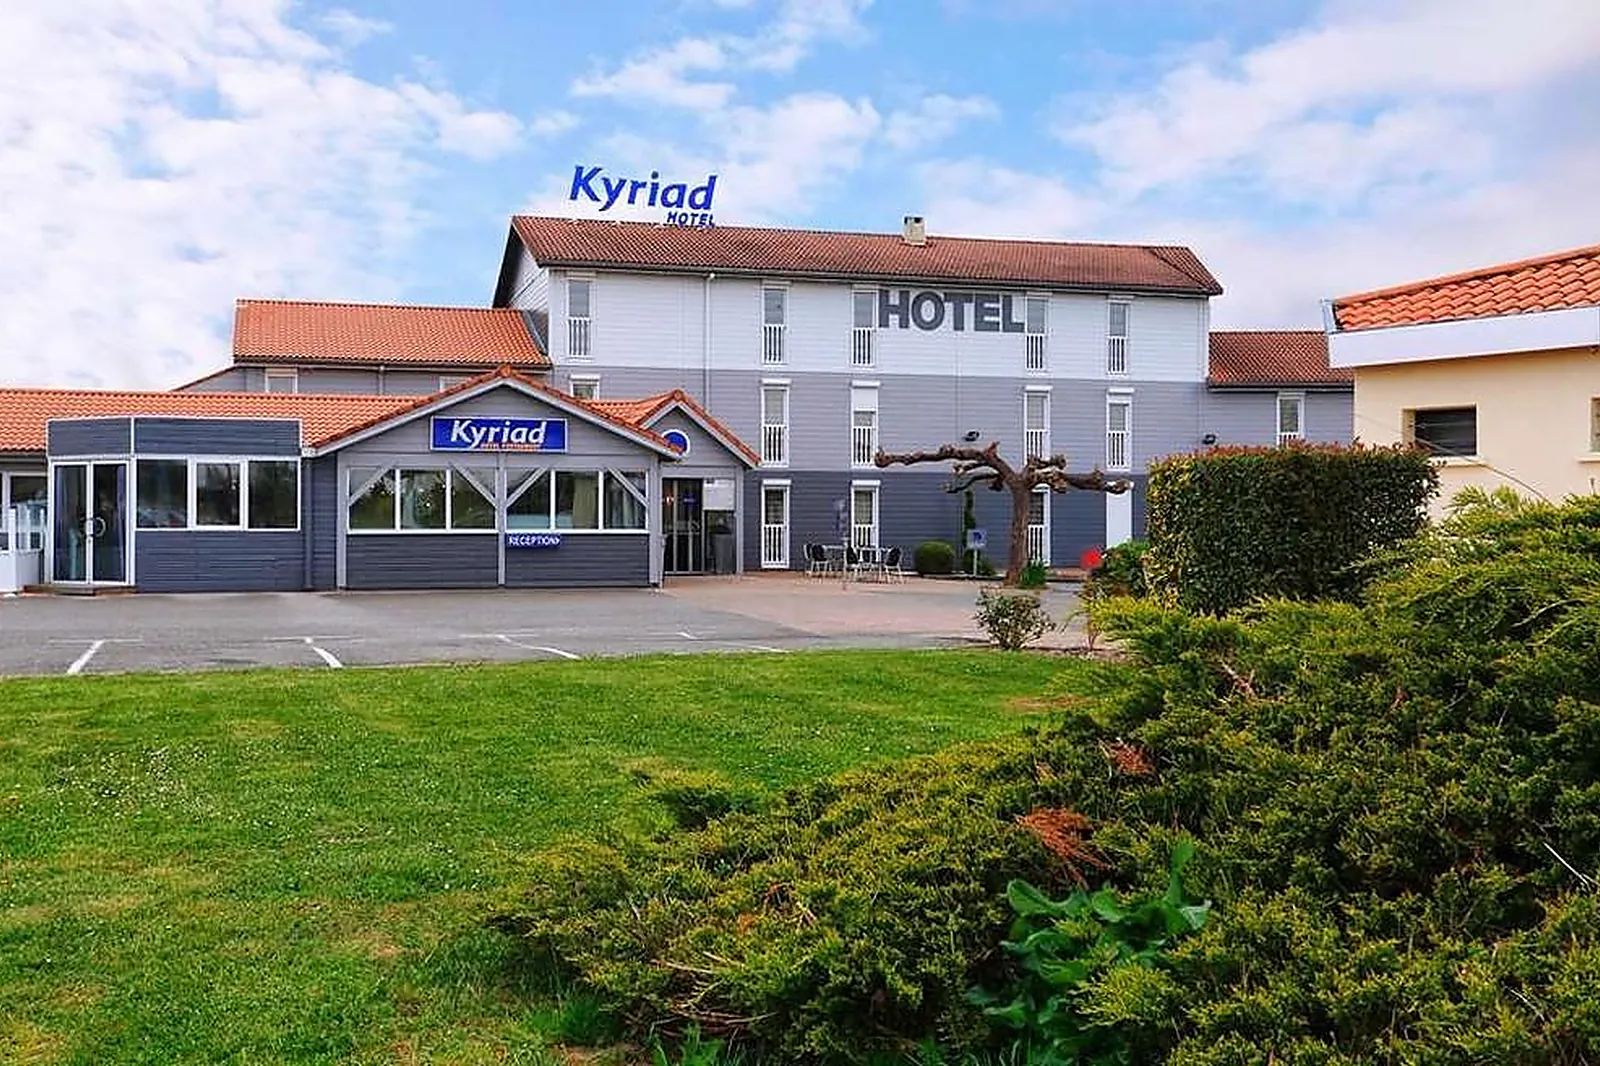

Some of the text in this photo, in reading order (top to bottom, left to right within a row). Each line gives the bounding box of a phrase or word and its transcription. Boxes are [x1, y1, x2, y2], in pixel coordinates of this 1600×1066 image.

[569, 165, 718, 212] Kyriad
[666, 211, 716, 227] HOTEL
[878, 289, 1025, 333] HOTEL
[450, 419, 548, 449] Kyriad
